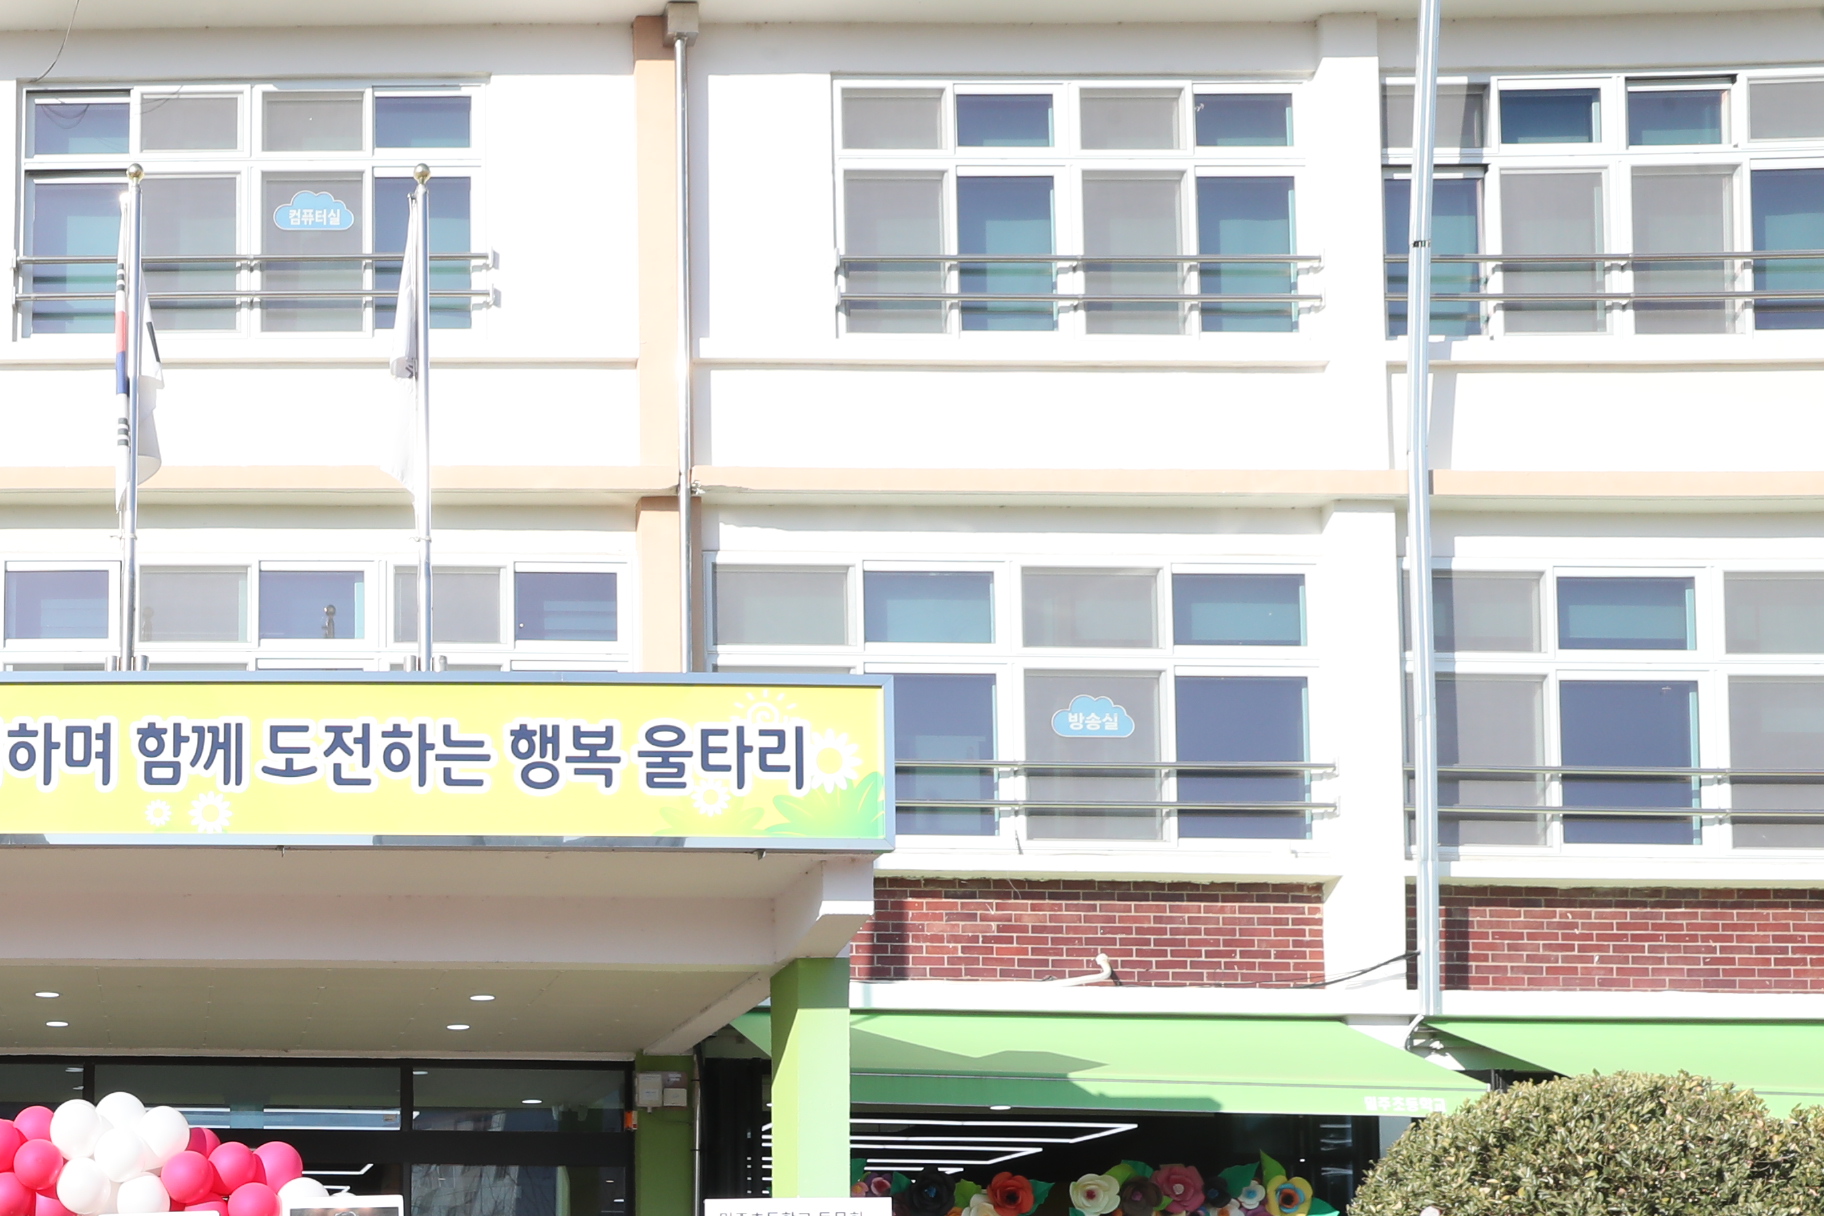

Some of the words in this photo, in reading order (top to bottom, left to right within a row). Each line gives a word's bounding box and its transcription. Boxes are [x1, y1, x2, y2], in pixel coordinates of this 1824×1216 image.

[289, 209, 341, 225] 컴퓨터실
[1068, 712, 1119, 731] 방송실
[136, 721, 244, 787] 함께
[261, 722, 492, 788] 도전하는
[509, 722, 622, 790] 행복
[637, 723, 805, 790] 울타리
